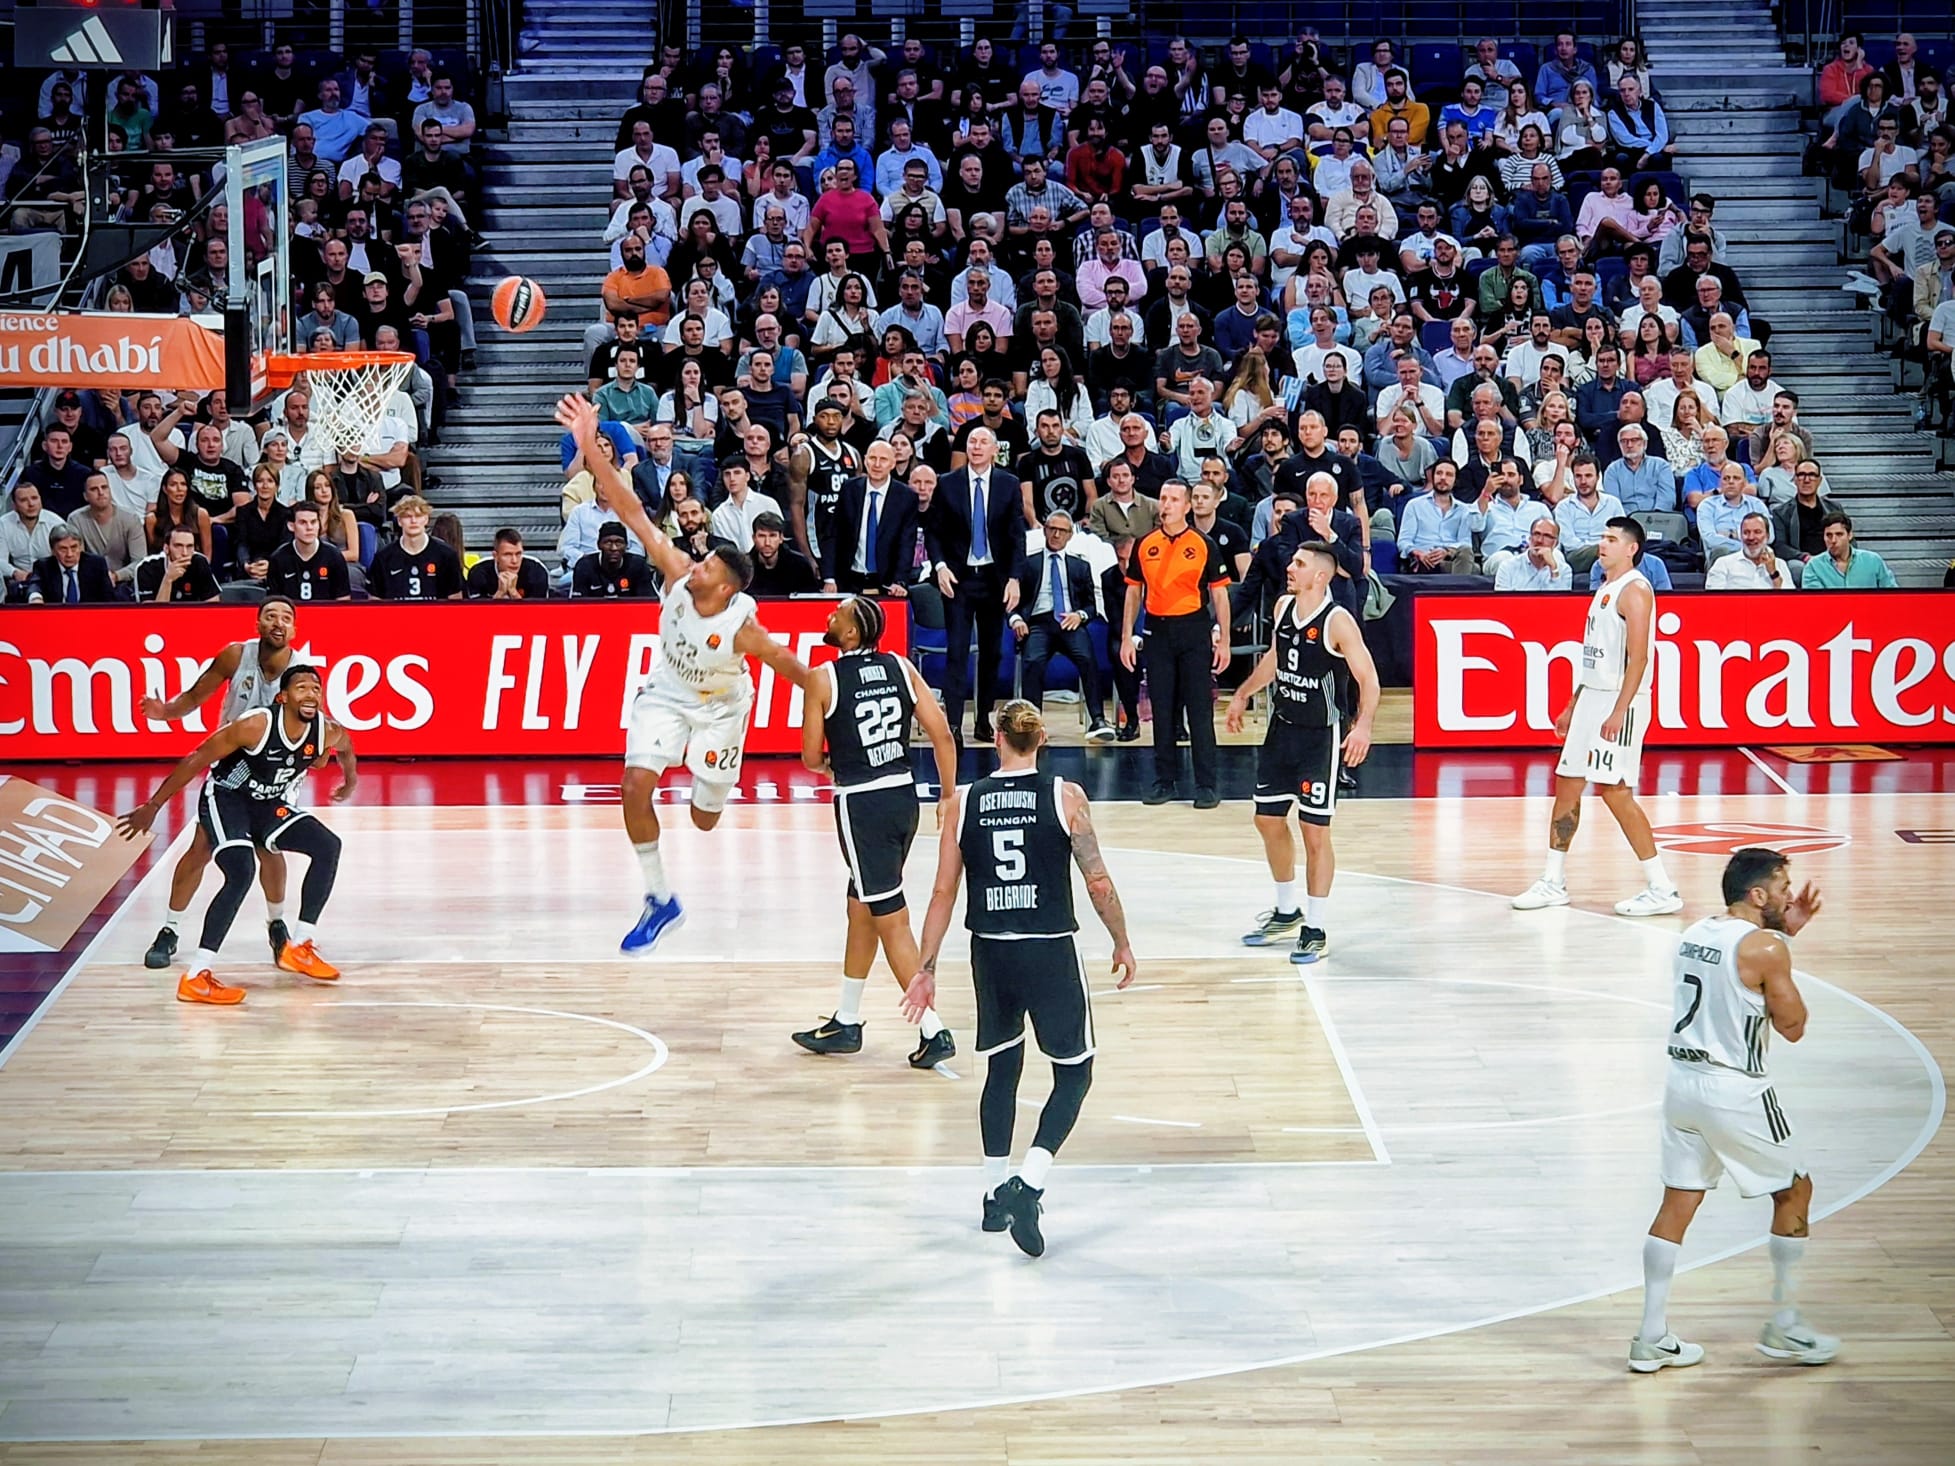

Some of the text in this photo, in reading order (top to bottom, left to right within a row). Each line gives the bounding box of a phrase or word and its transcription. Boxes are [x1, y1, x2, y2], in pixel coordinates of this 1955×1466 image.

[301, 582, 312, 600] 8
[409, 577, 421, 595] 3
[1287, 648, 1299, 672] 9
[1429, 612, 1955, 731] Eirate
[0, 633, 434, 735] mires
[482, 634, 600, 730] FLY
[855, 685, 898, 699] CHANGAN
[855, 696, 902, 747] 22
[719, 746, 739, 770] 22
[273, 768, 296, 785] 12
[979, 790, 1037, 813] OSETKOWSKI
[1311, 782, 1326, 805] 9
[979, 815, 1037, 826] CHANGAN
[992, 829, 1026, 881] 5
[1674, 973, 1703, 1034] 7
